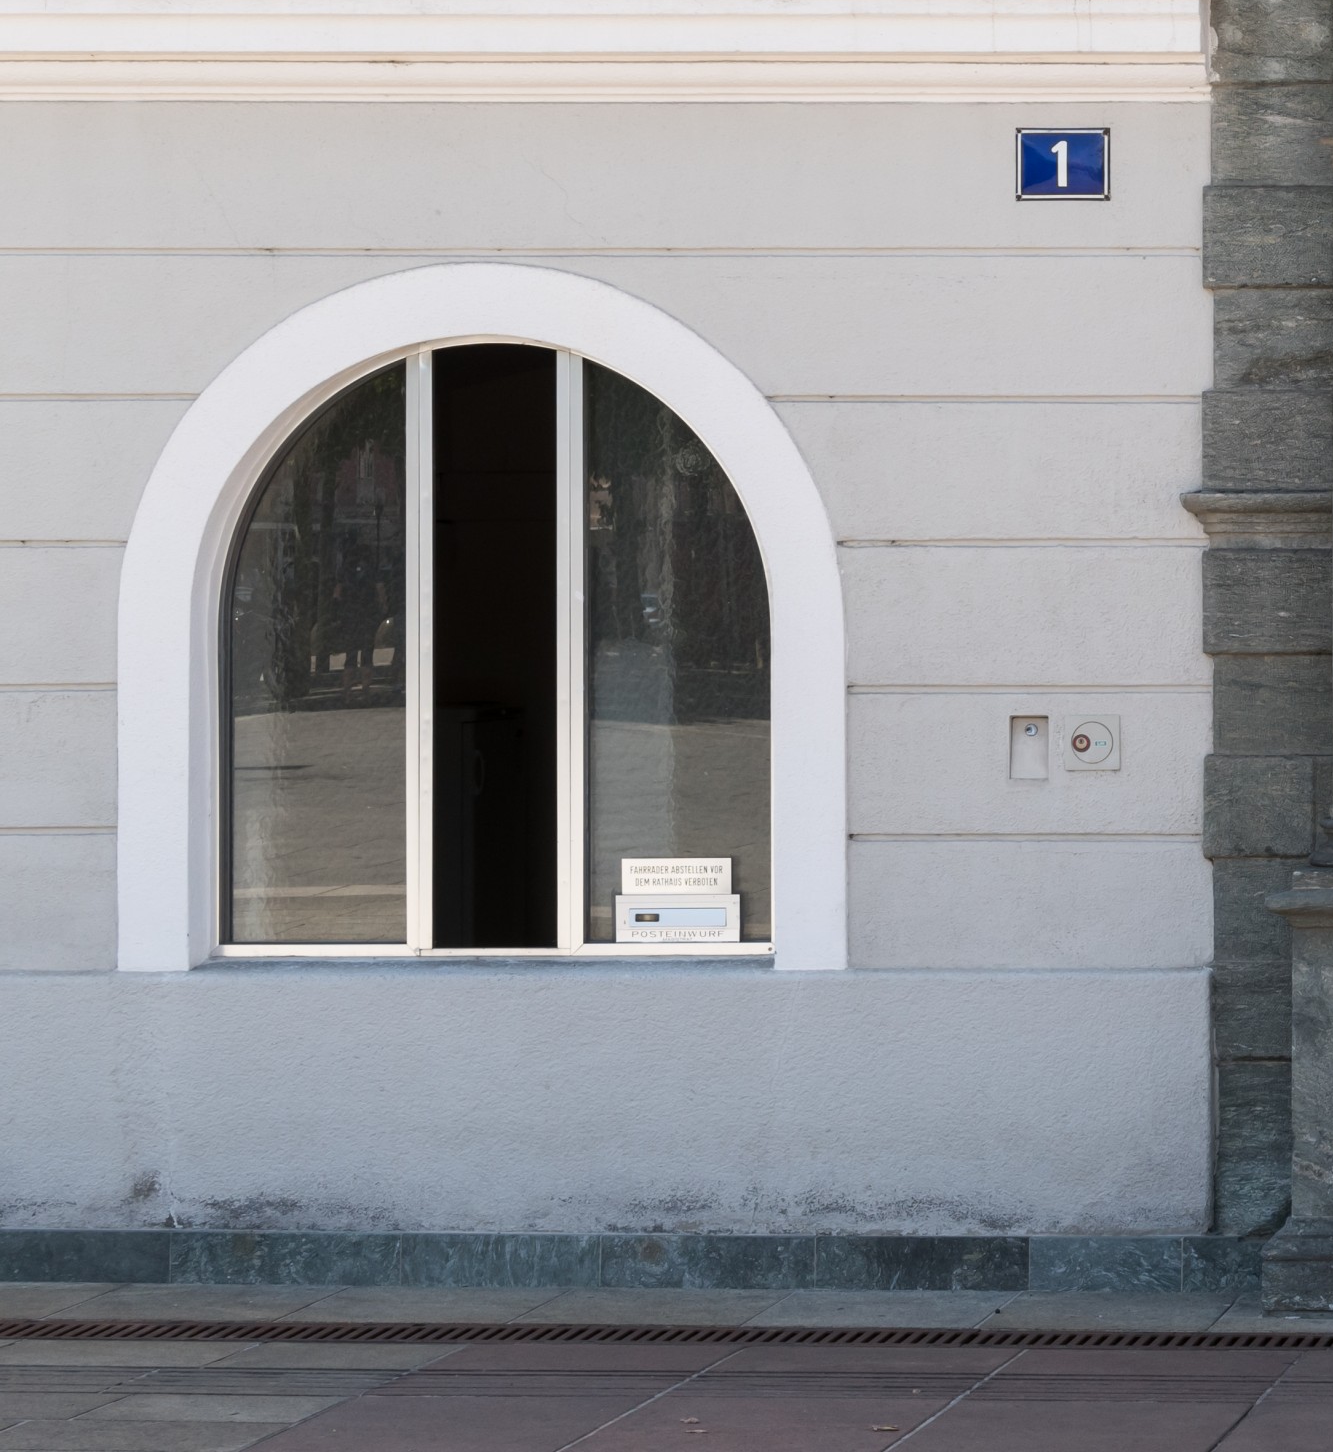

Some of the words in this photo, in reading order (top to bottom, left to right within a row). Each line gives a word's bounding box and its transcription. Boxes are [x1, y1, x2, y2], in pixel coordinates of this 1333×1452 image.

[1050, 140, 1068, 188] 1
[670, 865, 708, 874] ABSTELLEN
[710, 865, 723, 874] VOR
[635, 878, 650, 886] DEM
[652, 877, 682, 886] RATHAUS
[684, 877, 718, 886] VERBOTEN
[631, 930, 724, 938] POSTEINWURF
